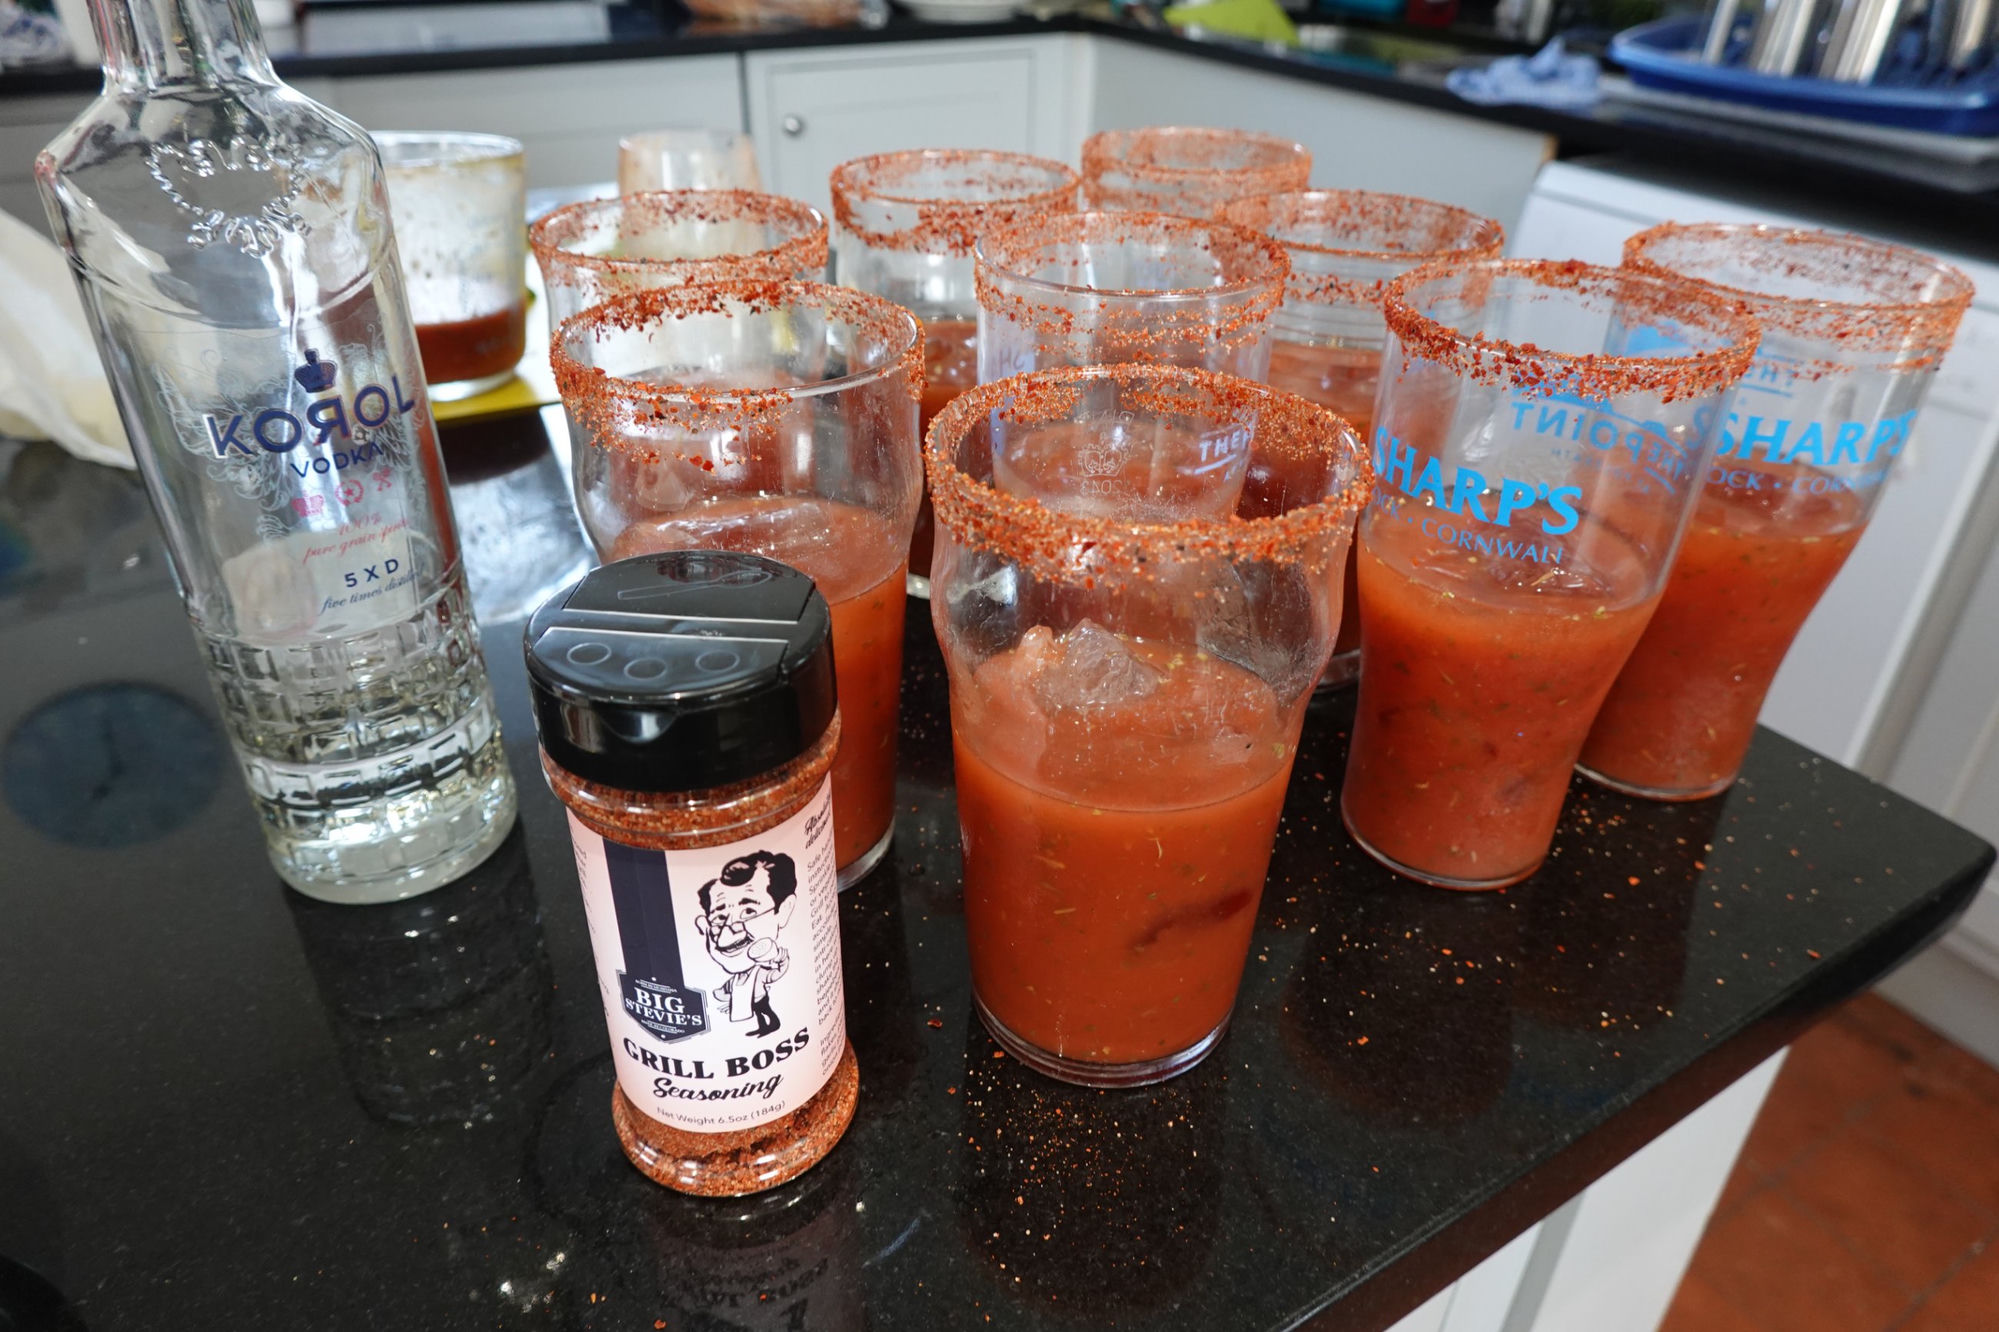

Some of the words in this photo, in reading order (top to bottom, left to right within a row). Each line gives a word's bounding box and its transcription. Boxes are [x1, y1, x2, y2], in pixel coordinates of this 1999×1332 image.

[290, 441, 384, 478] VODKA
[1373, 426, 1583, 535] SHARP'S
[319, 596, 347, 616] five
[349, 586, 382, 604] times
[625, 998, 703, 1026] STEVIE'S
[634, 987, 685, 1014] BIG
[623, 1037, 714, 1079] GRILL
[725, 1027, 810, 1077] BOSS
[653, 1074, 784, 1101] Seasoning
[656, 1107, 675, 1119] Net
[676, 1114, 715, 1126] Weight
[718, 1114, 748, 1124] 6.5oz
[750, 1101, 786, 1120] (184g)
